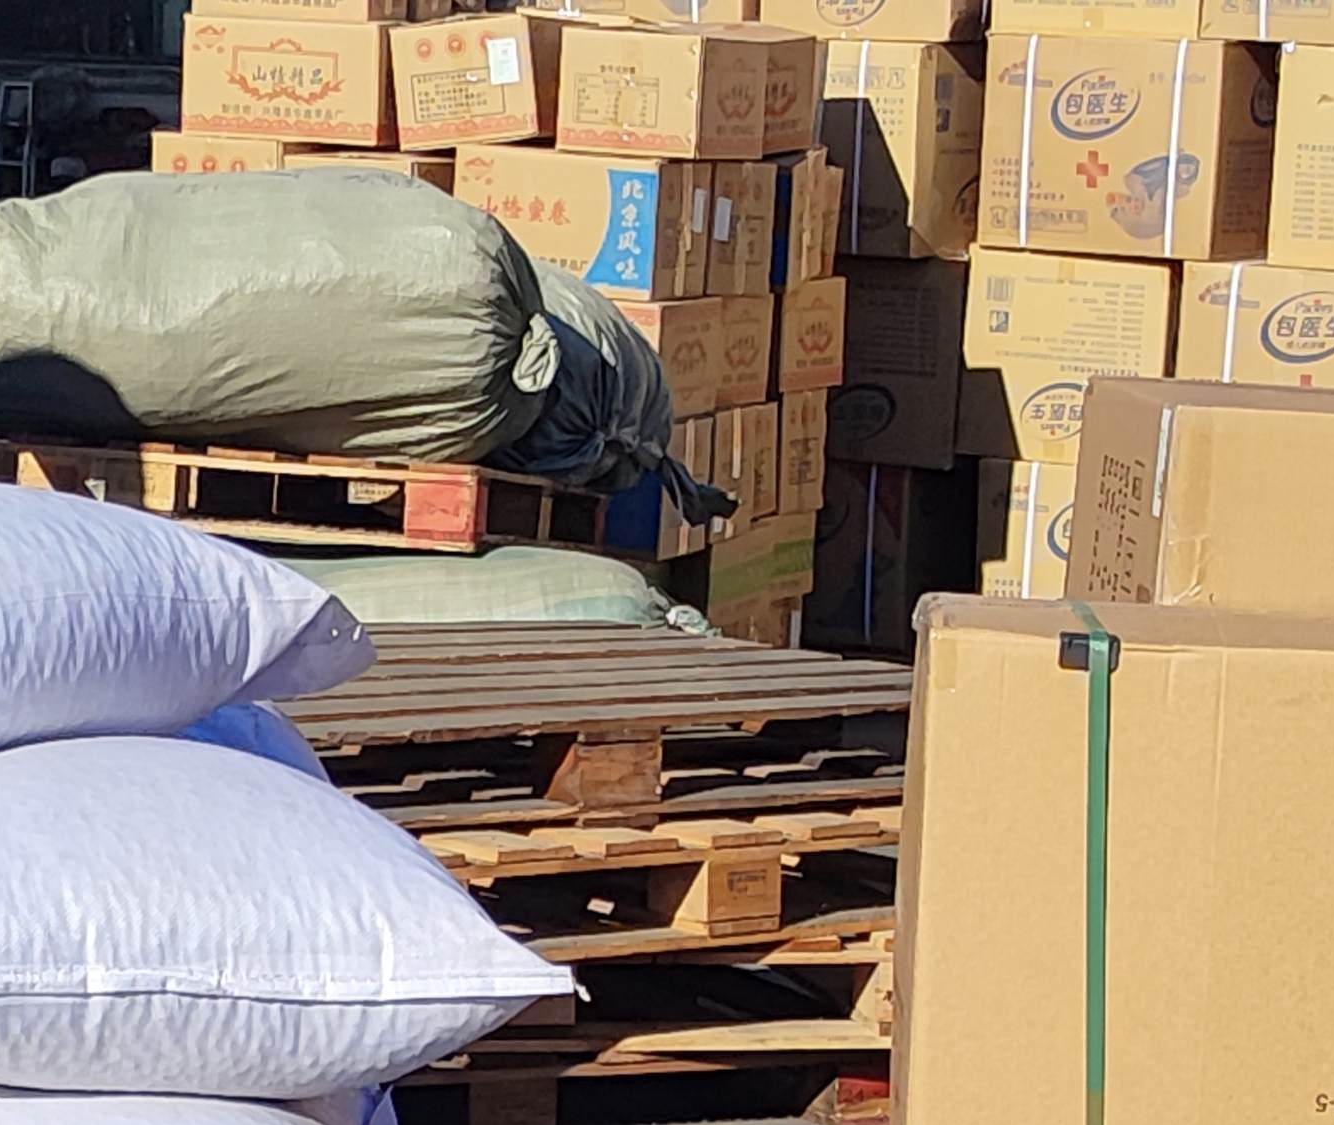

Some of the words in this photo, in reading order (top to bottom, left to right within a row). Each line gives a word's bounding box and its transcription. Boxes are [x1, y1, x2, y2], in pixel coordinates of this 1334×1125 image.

[1065, 93, 1129, 115] 包医生
[615, 179, 644, 281] 北京风味
